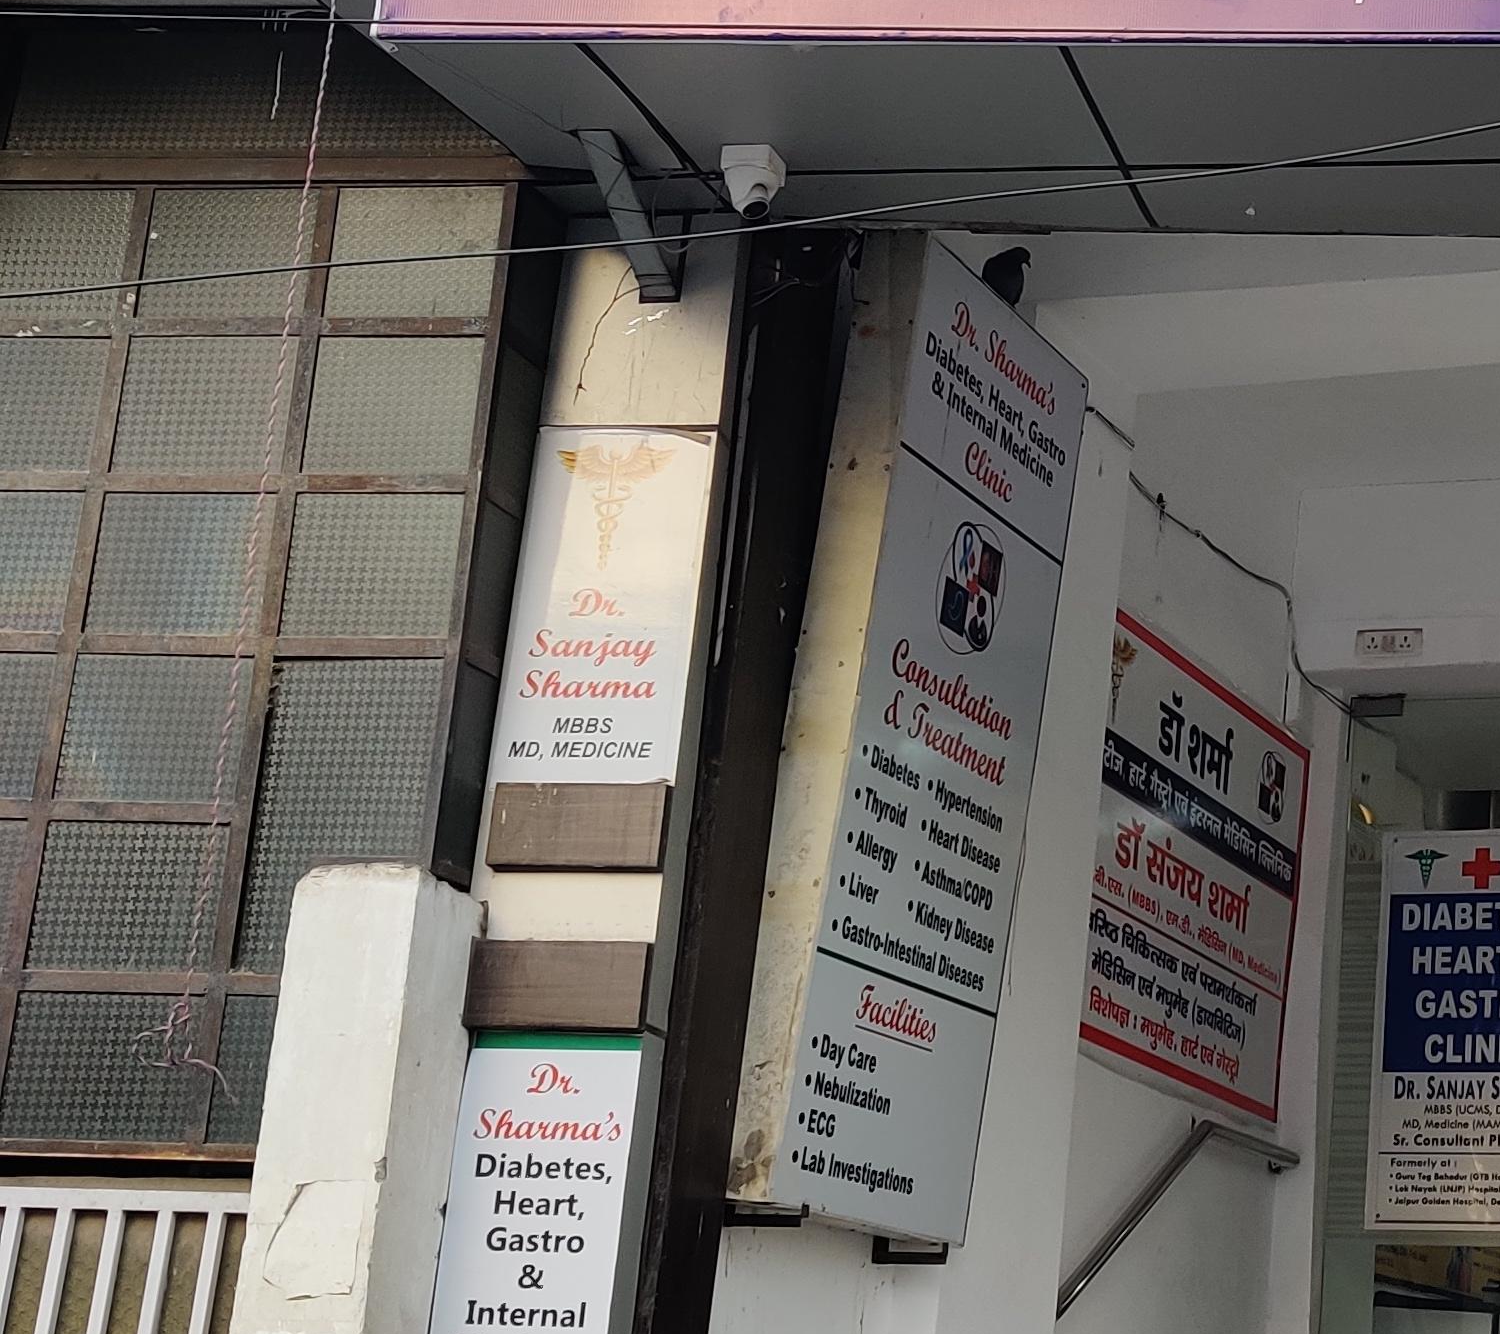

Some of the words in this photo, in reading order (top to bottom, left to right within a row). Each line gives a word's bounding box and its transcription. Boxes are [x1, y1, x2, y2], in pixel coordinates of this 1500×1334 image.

[951, 300, 979, 352] Dr.
[984, 329, 1056, 416] Sharma's
[925, 331, 984, 404] Diabetes,
[988, 384, 1025, 437] Heart,
[1028, 420, 1067, 467] Gastro
[931, 370, 944, 400] &
[946, 383, 999, 443] Internal
[1000, 426, 1054, 488] Medicine
[964, 441, 1014, 503] Clinic
[568, 587, 625, 618] Dr.
[528, 628, 657, 667] Sanjay
[518, 669, 657, 700] Sharma
[892, 638, 1012, 741] Consultation
[552, 717, 613, 734] MBBS
[883, 689, 904, 730] &
[907, 702, 1008, 786] Treatment
[1159, 691, 1185, 763] डॉ
[1188, 724, 1235, 795] शर्मा
[507, 741, 545, 761] MD,
[551, 741, 653, 759] MEDICINE
[870, 745, 921, 791] Diabetes
[865, 786, 909, 829] Thyroid
[855, 830, 898, 874] Allergy
[848, 871, 880, 905] Liver
[855, 984, 937, 1043] Facilities
[820, 1033, 846, 1069] Day
[847, 1043, 877, 1073] Care
[526, 1063, 582, 1095] Dr.
[813, 1071, 891, 1116] Nebulization
[473, 1108, 622, 1142] Sharma's
[806, 1108, 836, 1138] ECG
[475, 1153, 612, 1184] Diabetes,
[800, 1146, 826, 1175] Lab
[828, 1152, 914, 1195] Investigations
[493, 1190, 585, 1221] Heart,
[486, 1227, 585, 1254] Gastro
[518, 1264, 544, 1290] &
[465, 1300, 587, 1328] Internal
